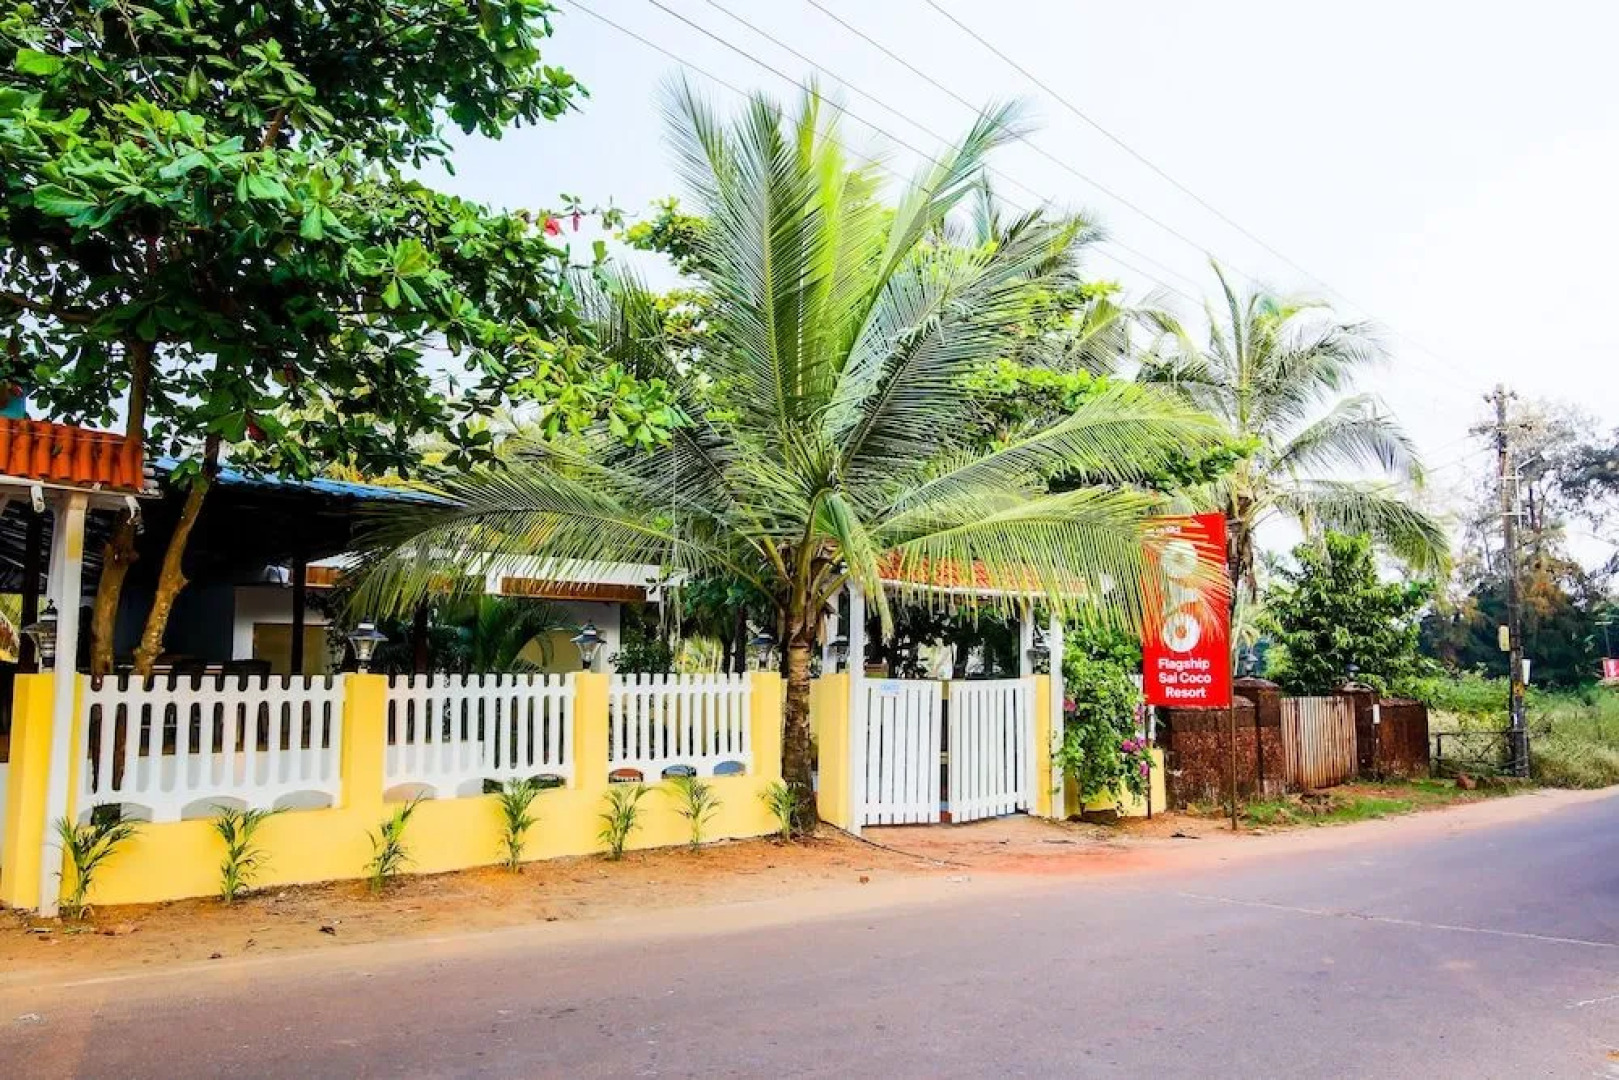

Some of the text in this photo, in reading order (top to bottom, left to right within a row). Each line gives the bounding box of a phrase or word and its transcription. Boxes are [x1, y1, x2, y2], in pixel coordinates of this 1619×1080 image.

[1158, 658, 1210, 672] Flagship
[1179, 672, 1211, 684] Coco
[1165, 686, 1207, 698] Resort
